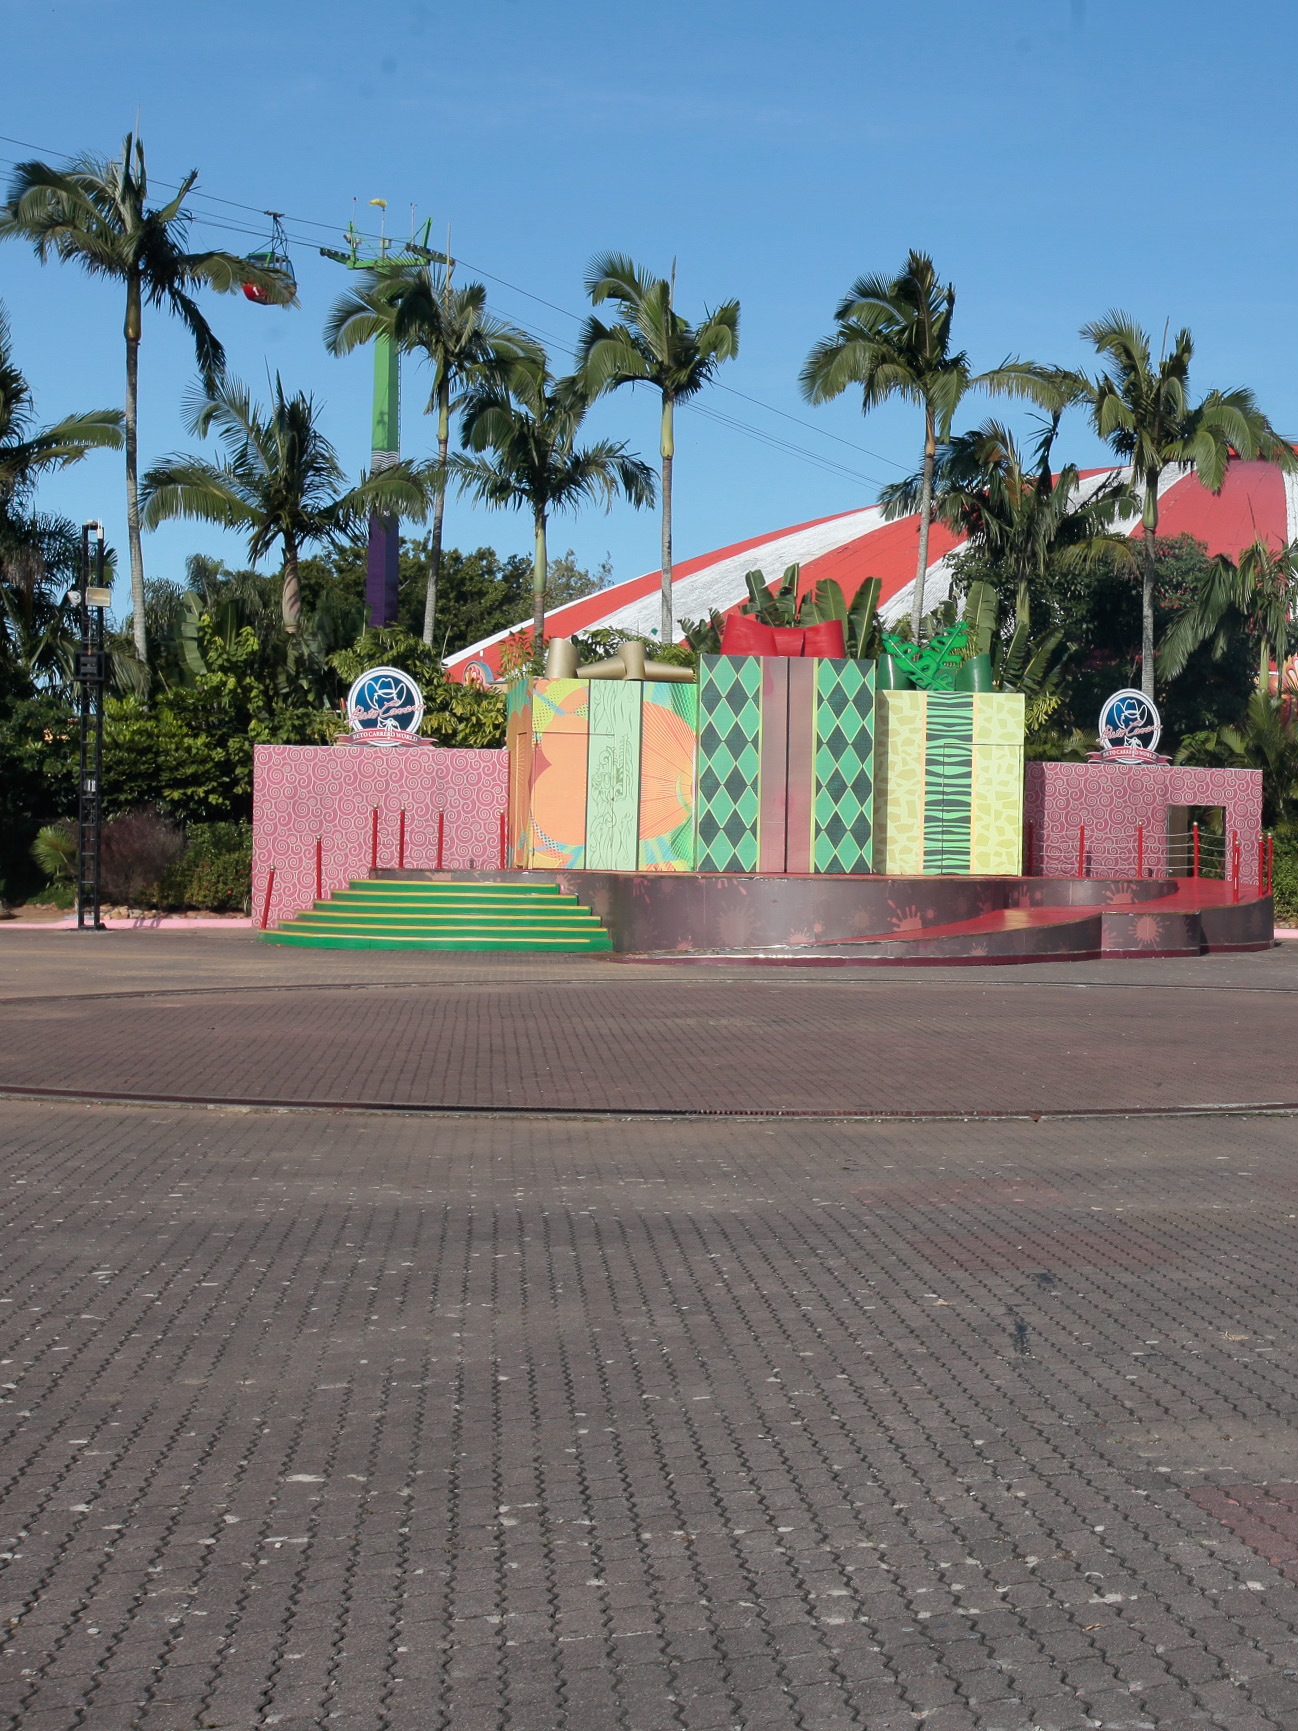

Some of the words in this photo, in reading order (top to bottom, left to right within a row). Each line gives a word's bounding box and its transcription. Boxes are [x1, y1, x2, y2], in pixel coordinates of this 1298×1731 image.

[352, 732, 368, 740] BETO
[396, 732, 418, 742] WORLD
[1139, 751, 1157, 759] WORLD
